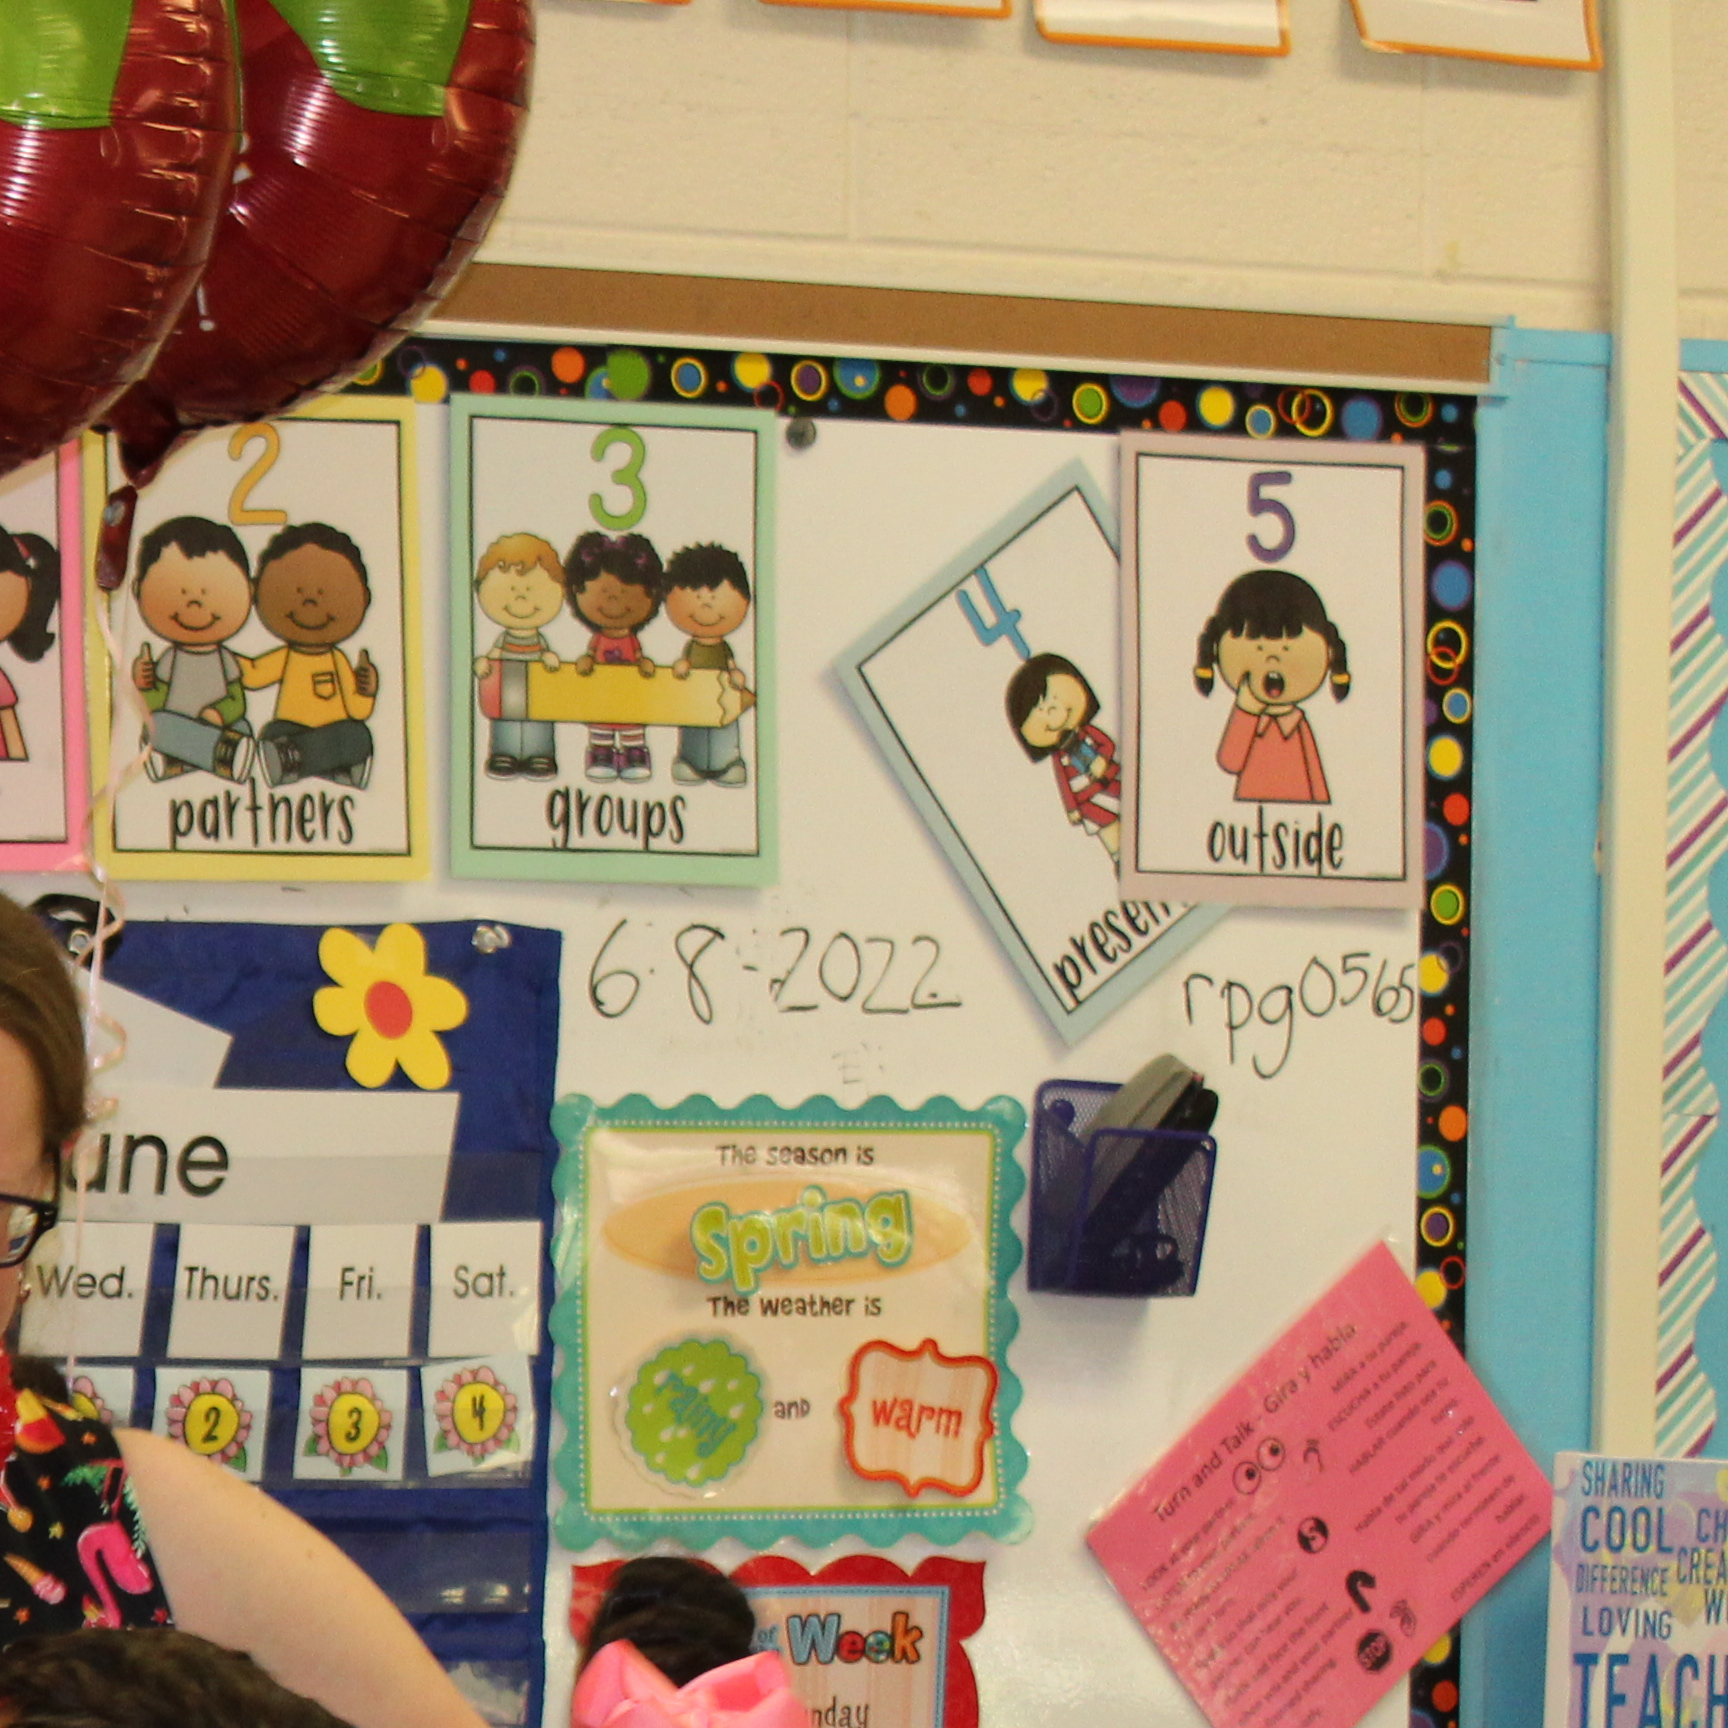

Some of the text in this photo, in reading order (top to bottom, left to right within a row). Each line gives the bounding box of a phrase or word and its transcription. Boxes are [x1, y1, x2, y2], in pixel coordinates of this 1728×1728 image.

[228, 421, 288, 527] 2
[588, 427, 648, 530] 3
[1246, 472, 1296, 562] 5
[955, 565, 1031, 659] 4
[167, 790, 356, 848] partners
[545, 786, 687, 848] groups
[1207, 804, 1344, 874] outside
[1050, 896, 1190, 1005] presen
[715, 1144, 874, 1166] The season is
[689, 1186, 912, 1294] Spring
[36, 1264, 134, 1300] Wed.
[183, 1265, 279, 1301] Thurs.
[338, 1265, 382, 1300] Fri.
[452, 1264, 514, 1298] Sat.
[706, 1294, 882, 1318] The weather is
[203, 1406, 220, 1442] 2
[345, 1408, 361, 1440] 3
[471, 1397, 486, 1428] 4
[773, 1398, 810, 1422] and
[871, 1401, 963, 1443] warm
[1187, 1448, 1223, 1489] and
[1219, 1416, 1255, 1456] Talk
[1260, 1373, 1299, 1416] Gira
[1296, 1363, 1314, 1385] y
[1306, 1315, 1357, 1371] habla
[1582, 1460, 1666, 1499] SHARING
[1581, 1506, 1673, 1553] COOL
[1576, 1564, 1669, 1597] DIFFERENCE
[787, 1611, 923, 1665] Week
[1583, 1606, 1671, 1640] LOVING
